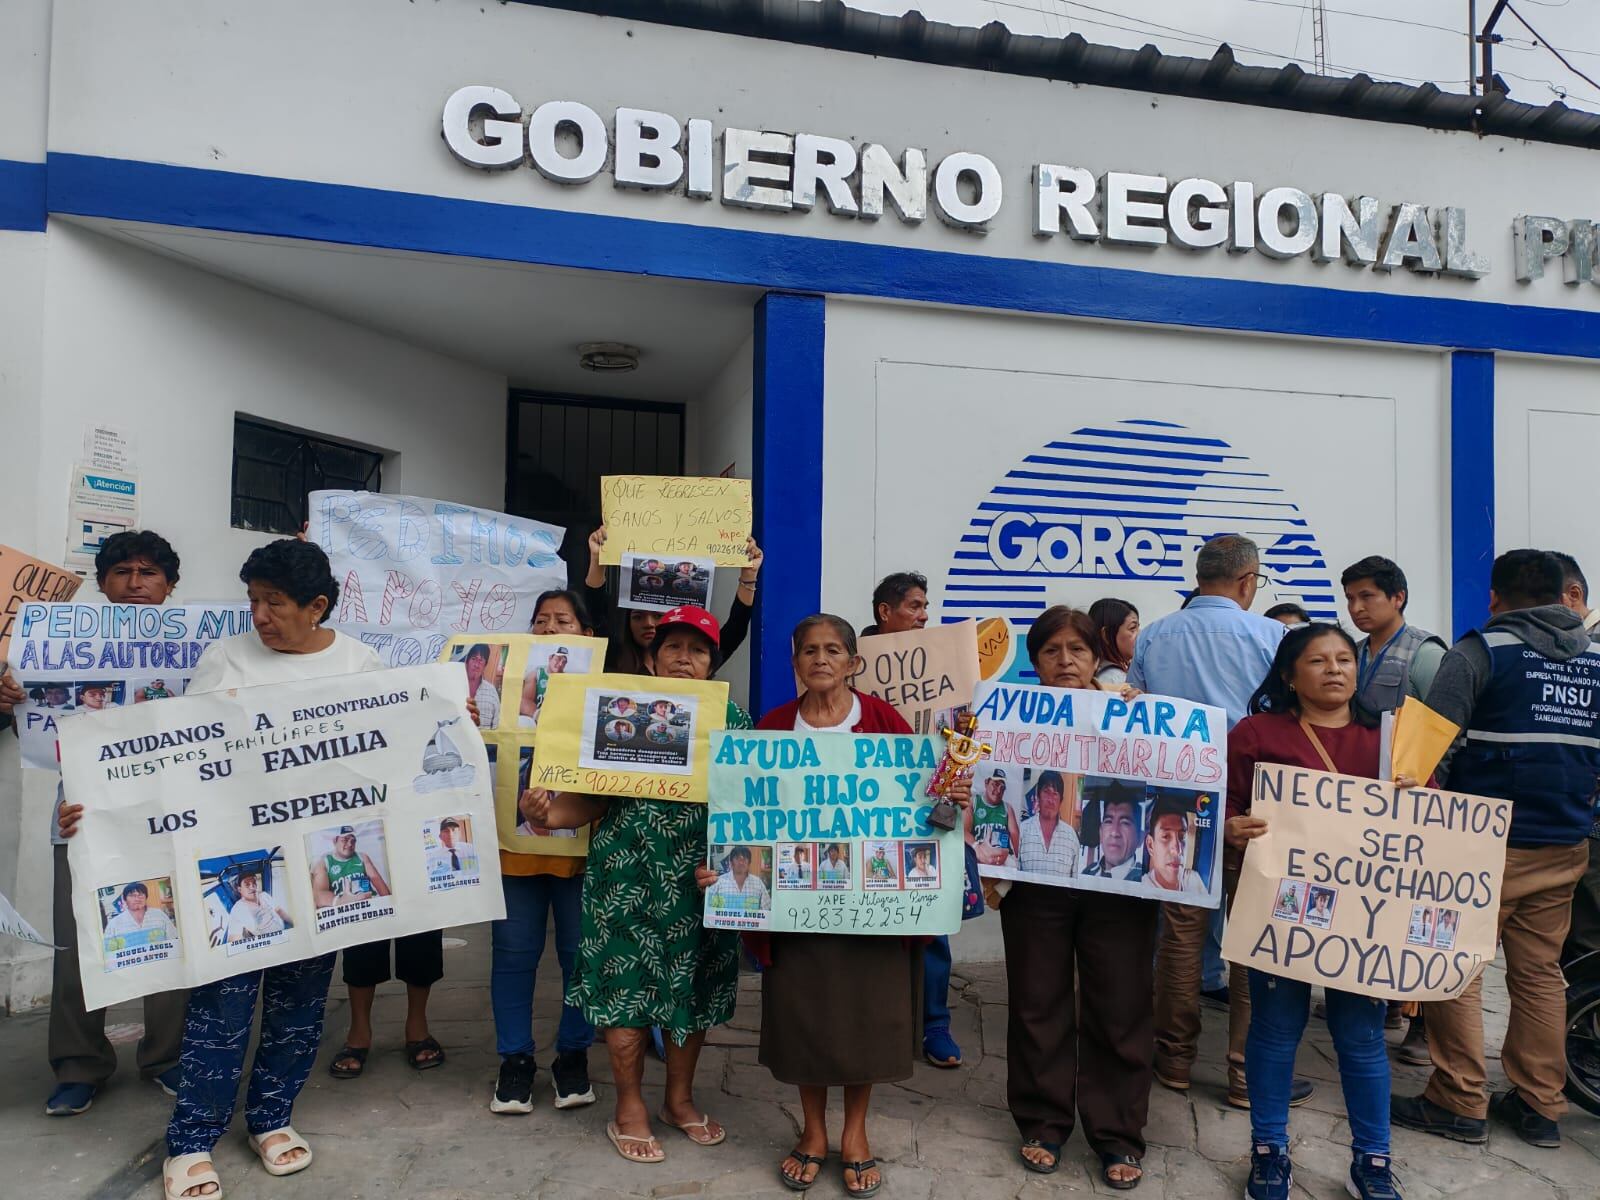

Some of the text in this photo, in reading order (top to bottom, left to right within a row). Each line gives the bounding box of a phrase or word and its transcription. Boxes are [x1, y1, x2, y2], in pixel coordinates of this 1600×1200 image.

[441, 85, 1600, 286] GOBIERNO REGIONAL PI
[94, 479, 132, 492] ¡Atención!
[613, 479, 646, 505] QUE
[316, 495, 557, 568] PEDIMOS
[610, 509, 662, 529] SANOS
[688, 508, 742, 527] SALVOS
[627, 536, 698, 552] A CASA
[706, 543, 747, 555] 90226186
[339, 570, 516, 632] APOYO
[21, 605, 188, 639] PEDIMOS
[98, 642, 211, 669] AUTORID
[1542, 683, 1592, 707] PNSU
[98, 722, 225, 761] AYUDANOS
[254, 713, 274, 731] A
[292, 690, 409, 722] ENCONTRALOS
[973, 687, 1211, 743] AYUDA PARA
[107, 748, 207, 780] NUESTROS
[199, 729, 387, 781] SU FAMILIA
[715, 735, 936, 769] AYUDA PARA
[974, 731, 1223, 784] ENCONTRARLOS
[538, 765, 692, 799] YAPE: 902261862
[744, 772, 921, 807] MI HIJO Y
[147, 784, 387, 834] LOS ESPERAN
[709, 806, 936, 844] TRIPULANTES
[1359, 828, 1424, 865] SER
[1287, 848, 1492, 908] ESCUCHADOS
[317, 900, 371, 920] LUIS MANUEL
[362, 907, 394, 920] DURAND
[788, 905, 924, 930] 928372254
[1360, 895, 1386, 939] Y
[116, 947, 147, 959] MIGUEL
